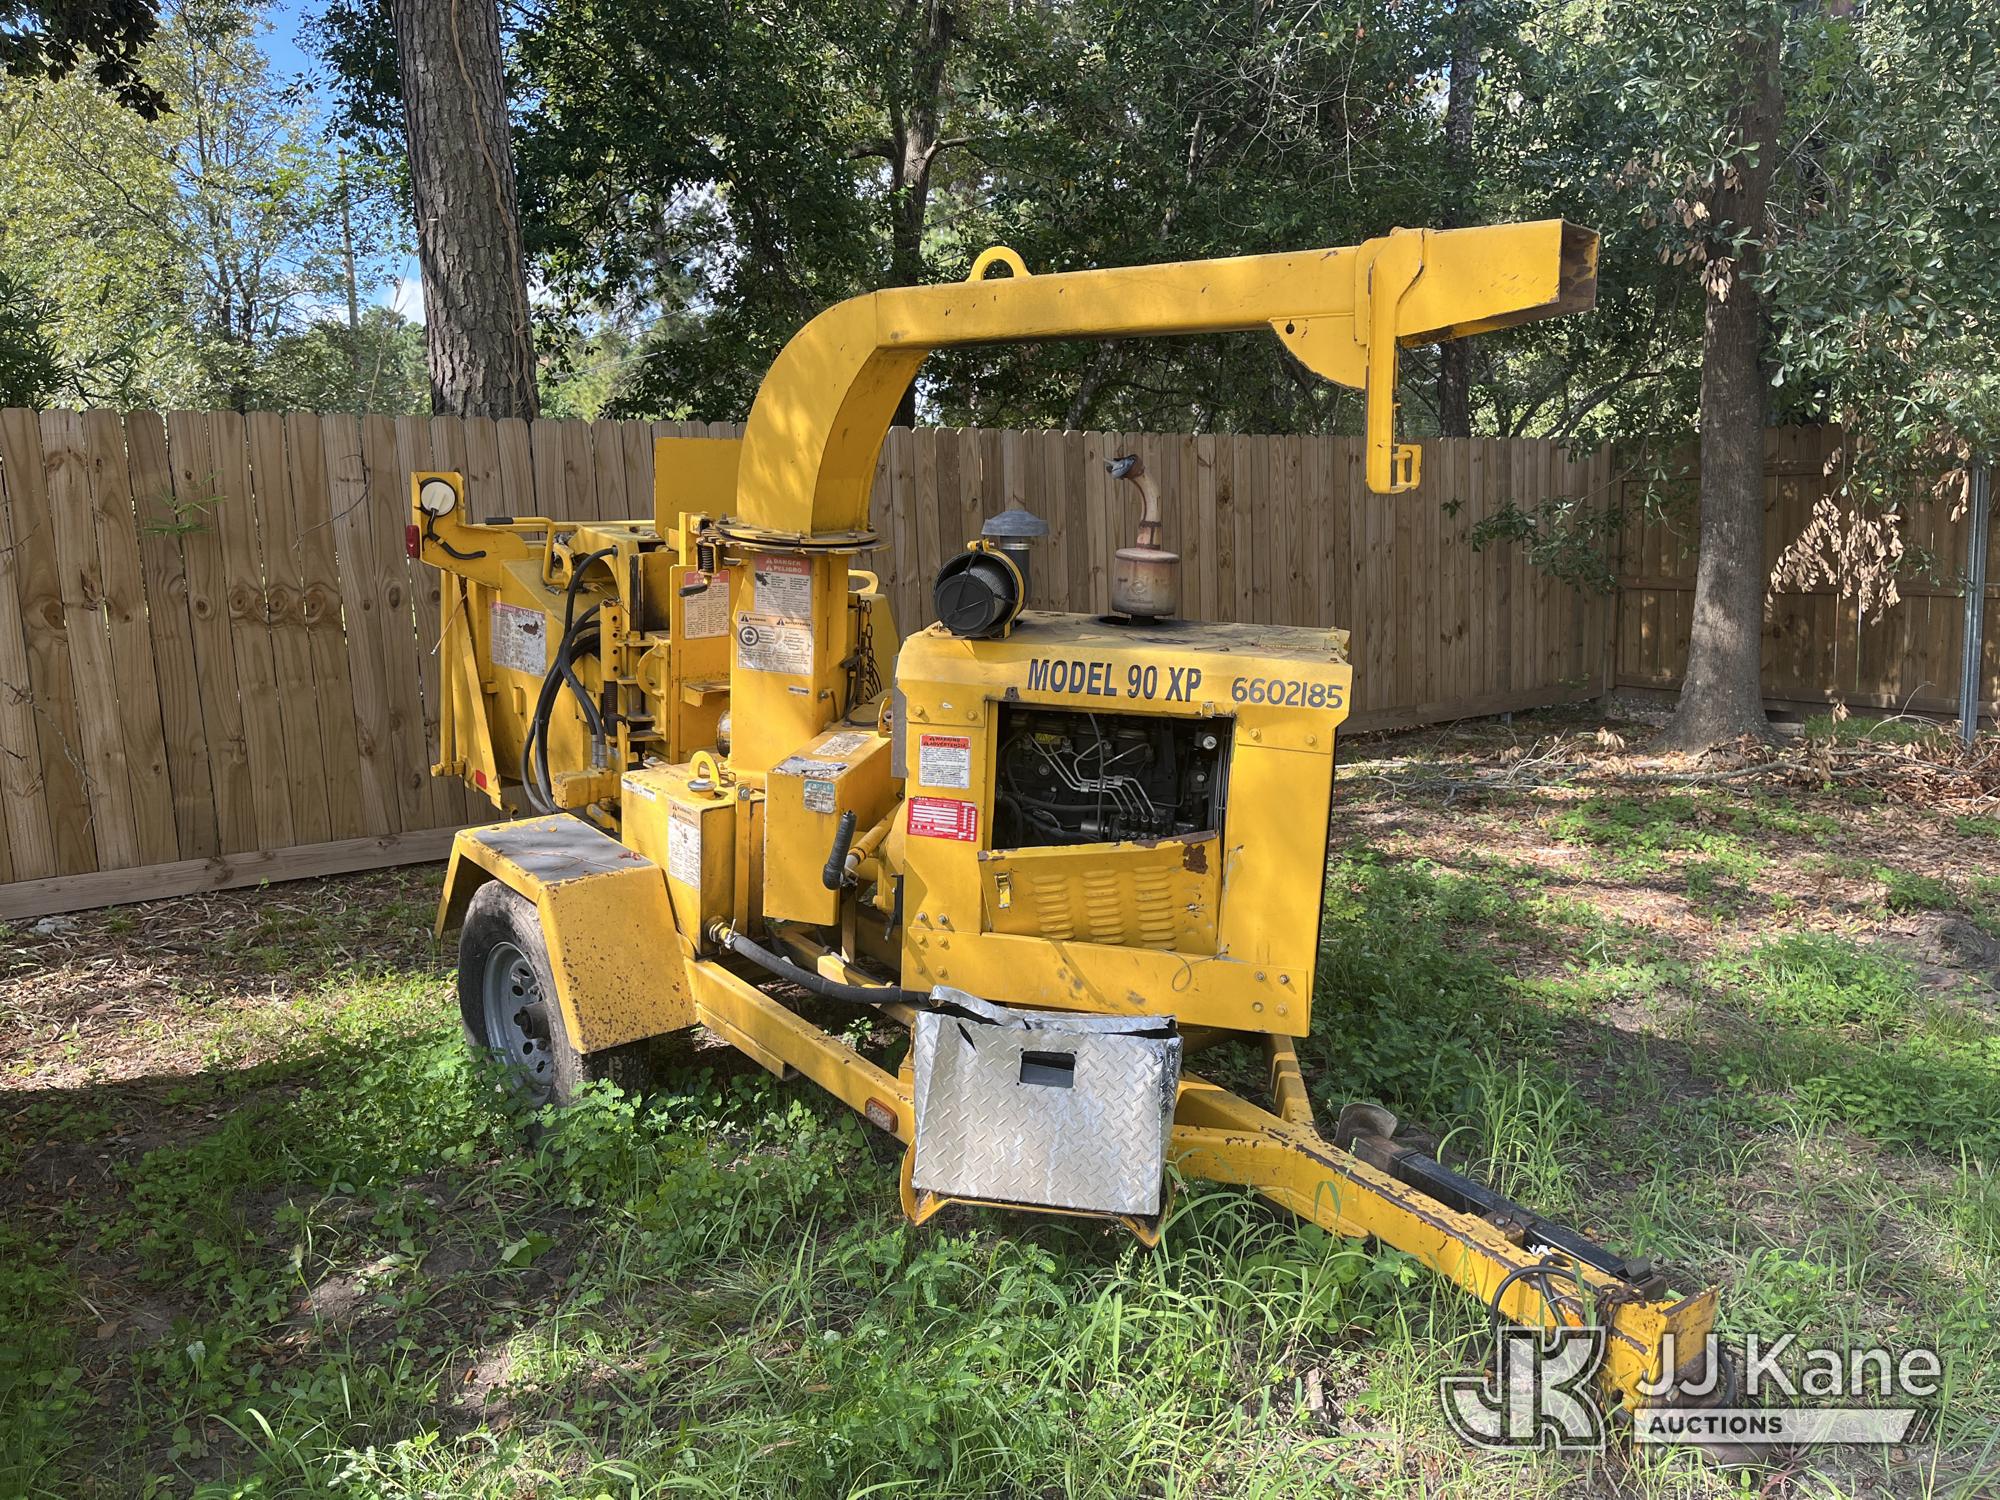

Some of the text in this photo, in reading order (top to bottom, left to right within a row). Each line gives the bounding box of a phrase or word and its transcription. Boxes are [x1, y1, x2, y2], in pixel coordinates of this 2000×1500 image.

[1026, 658, 1202, 703] MODEL 90 XP
[1231, 676, 1344, 710] 6602185
